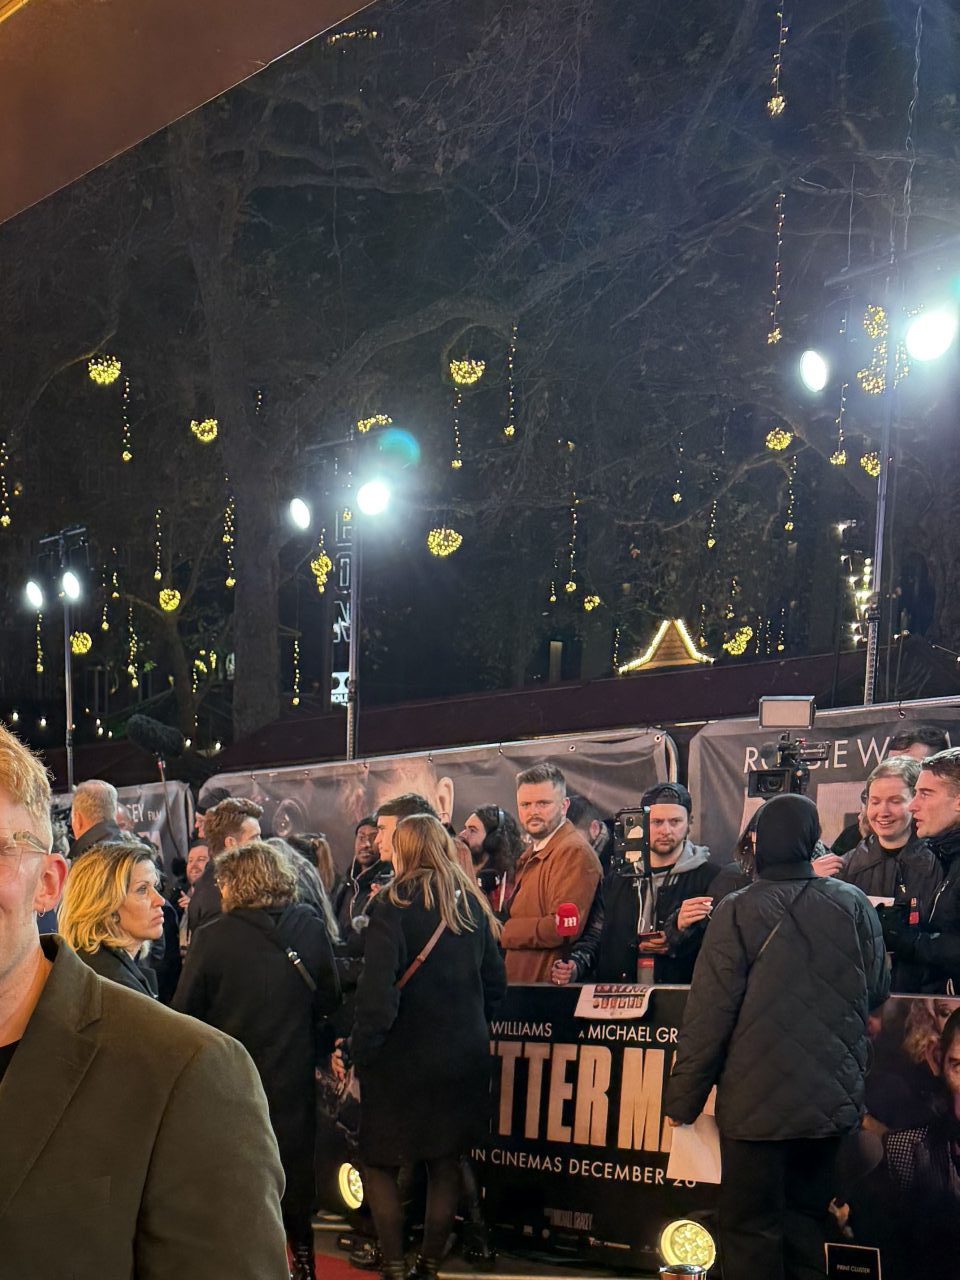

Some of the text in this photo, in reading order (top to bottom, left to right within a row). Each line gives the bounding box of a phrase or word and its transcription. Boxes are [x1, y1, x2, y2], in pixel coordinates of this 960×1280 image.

[490, 1021, 553, 1038] WILLIAMS
[587, 1024, 652, 1042] MICHAEL
[489, 1040, 613, 1147] TTER
[491, 1150, 562, 1174] CINEMAS
[568, 1159, 665, 1185] DECEMBER
